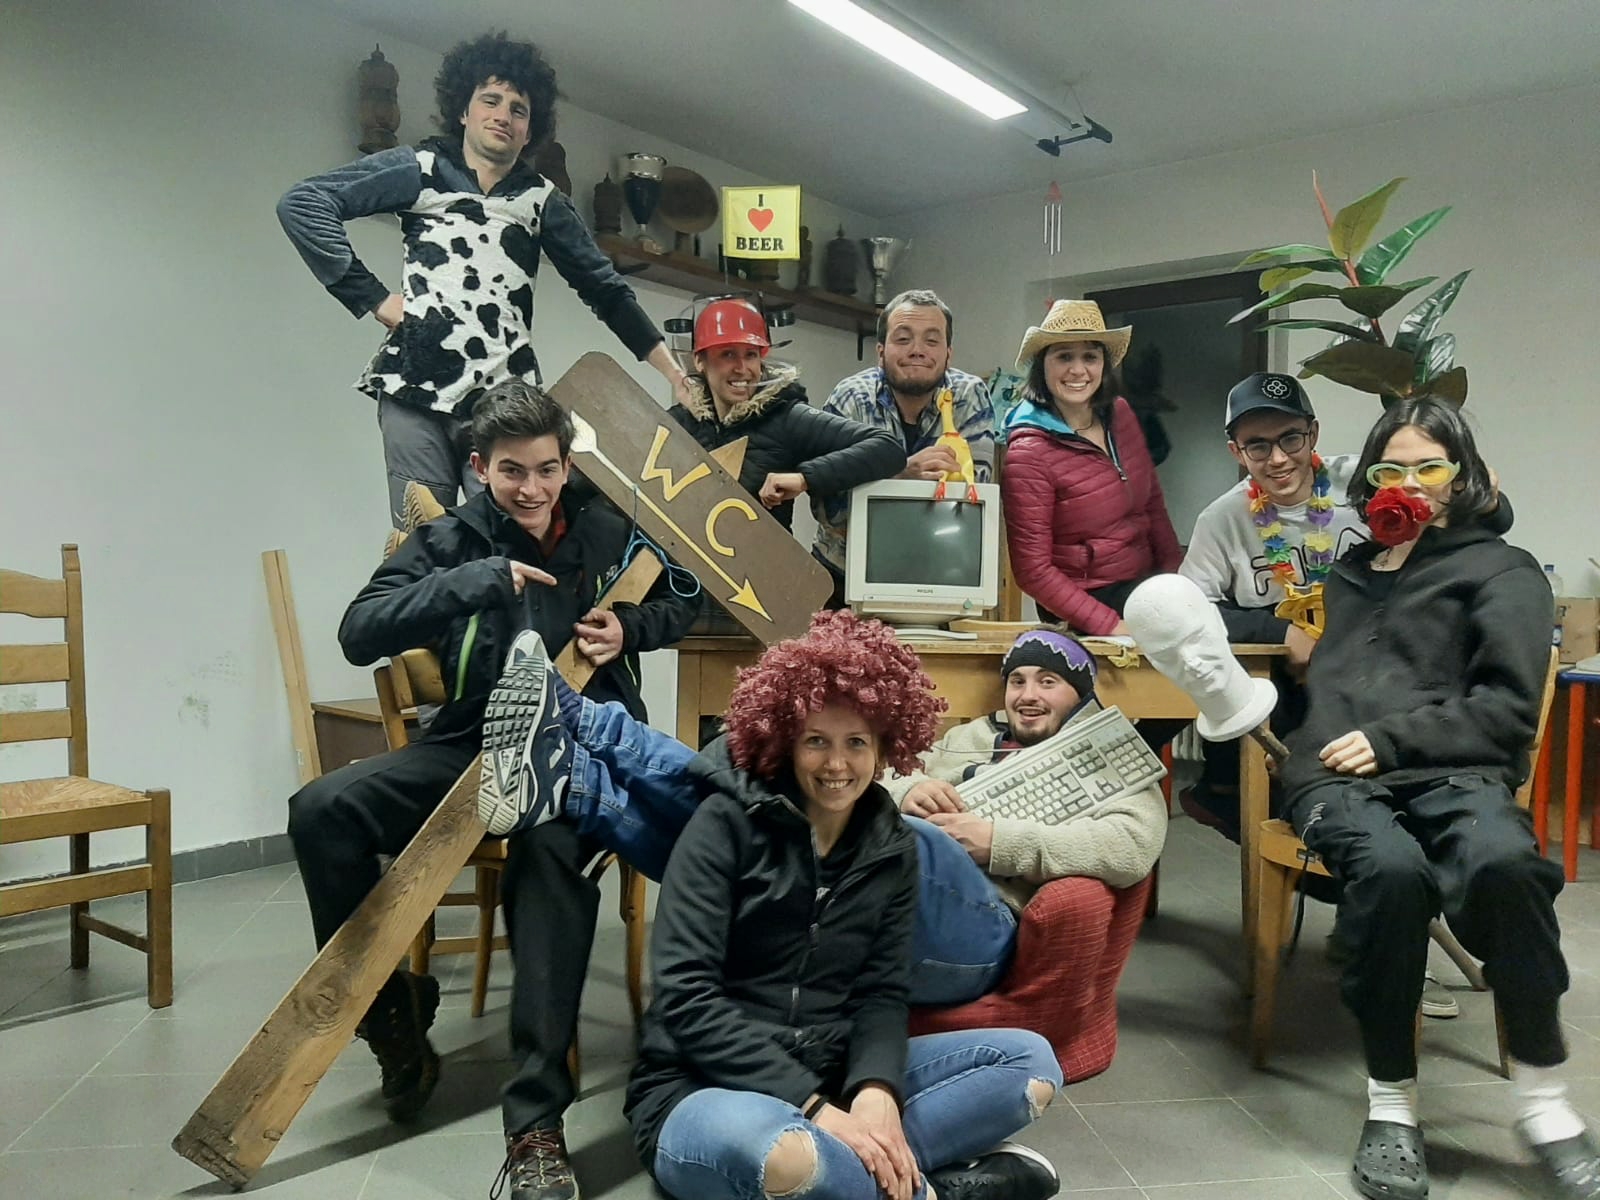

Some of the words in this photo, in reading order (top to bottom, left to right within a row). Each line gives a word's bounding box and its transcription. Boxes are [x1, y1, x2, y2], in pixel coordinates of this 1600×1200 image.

[758, 194, 764, 207] I
[736, 236, 784, 251] BEER
[640, 424, 759, 557] WC
[1250, 526, 1375, 596] FIA
